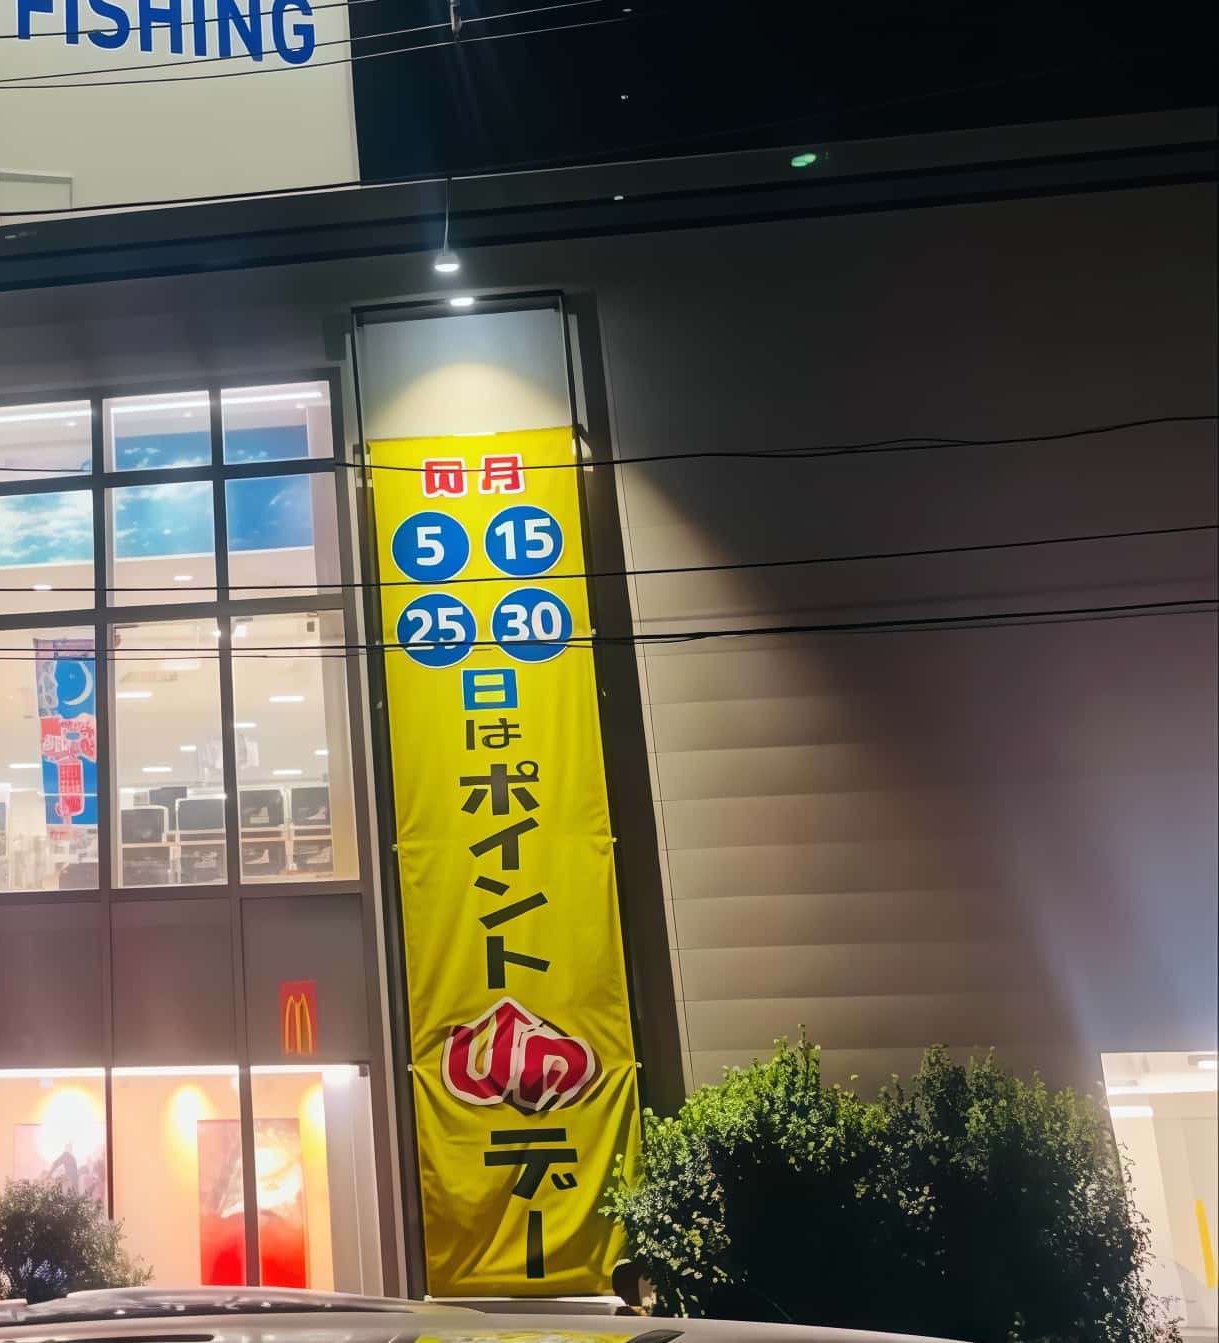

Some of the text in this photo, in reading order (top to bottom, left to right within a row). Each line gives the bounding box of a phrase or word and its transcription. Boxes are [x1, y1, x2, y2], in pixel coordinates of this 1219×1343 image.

[416, 517, 554, 566] 5 15
[406, 601, 562, 651] 25 30
